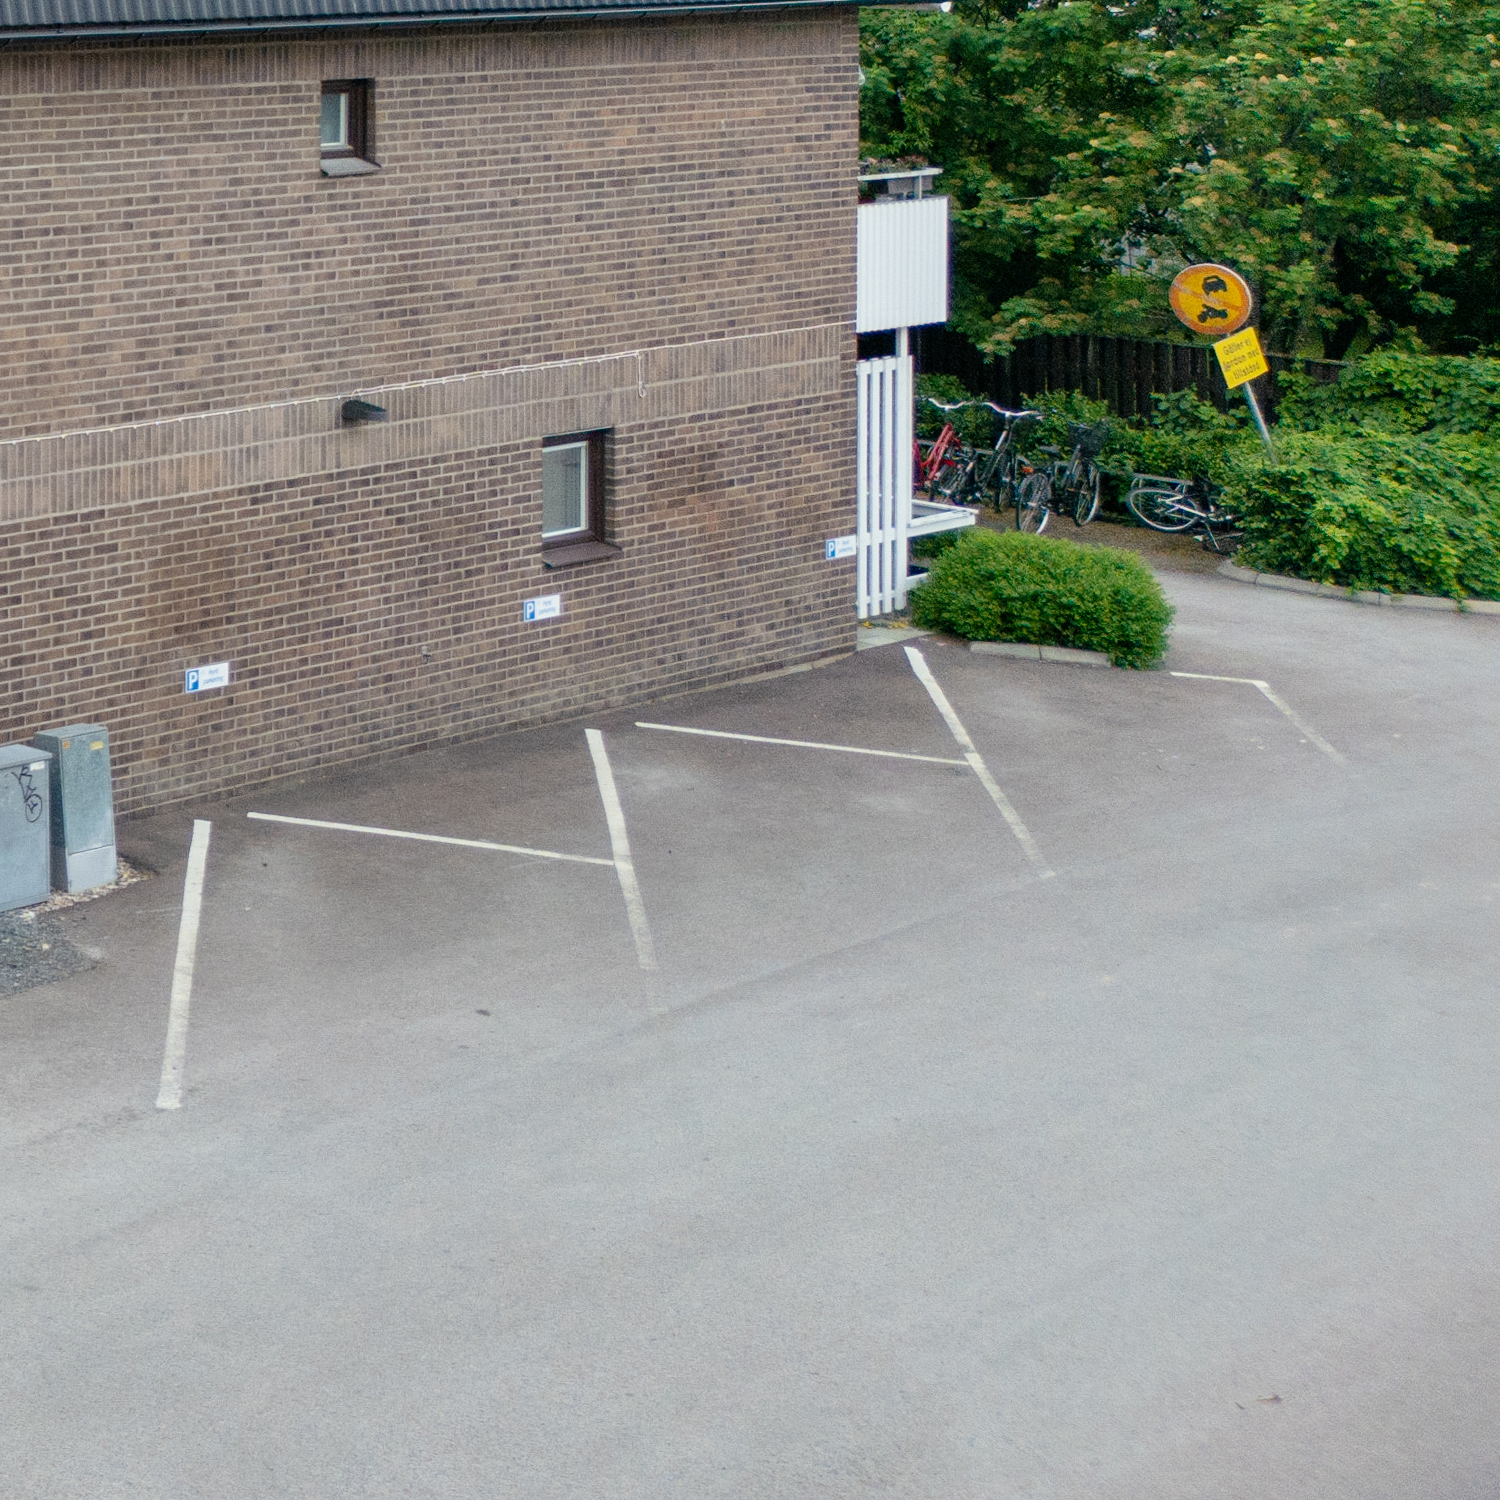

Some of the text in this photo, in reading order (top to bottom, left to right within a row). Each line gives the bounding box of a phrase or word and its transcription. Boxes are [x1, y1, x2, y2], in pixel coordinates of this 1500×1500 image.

[828, 541, 835, 557] P
[526, 602, 534, 620] P
[188, 671, 198, 690] P
